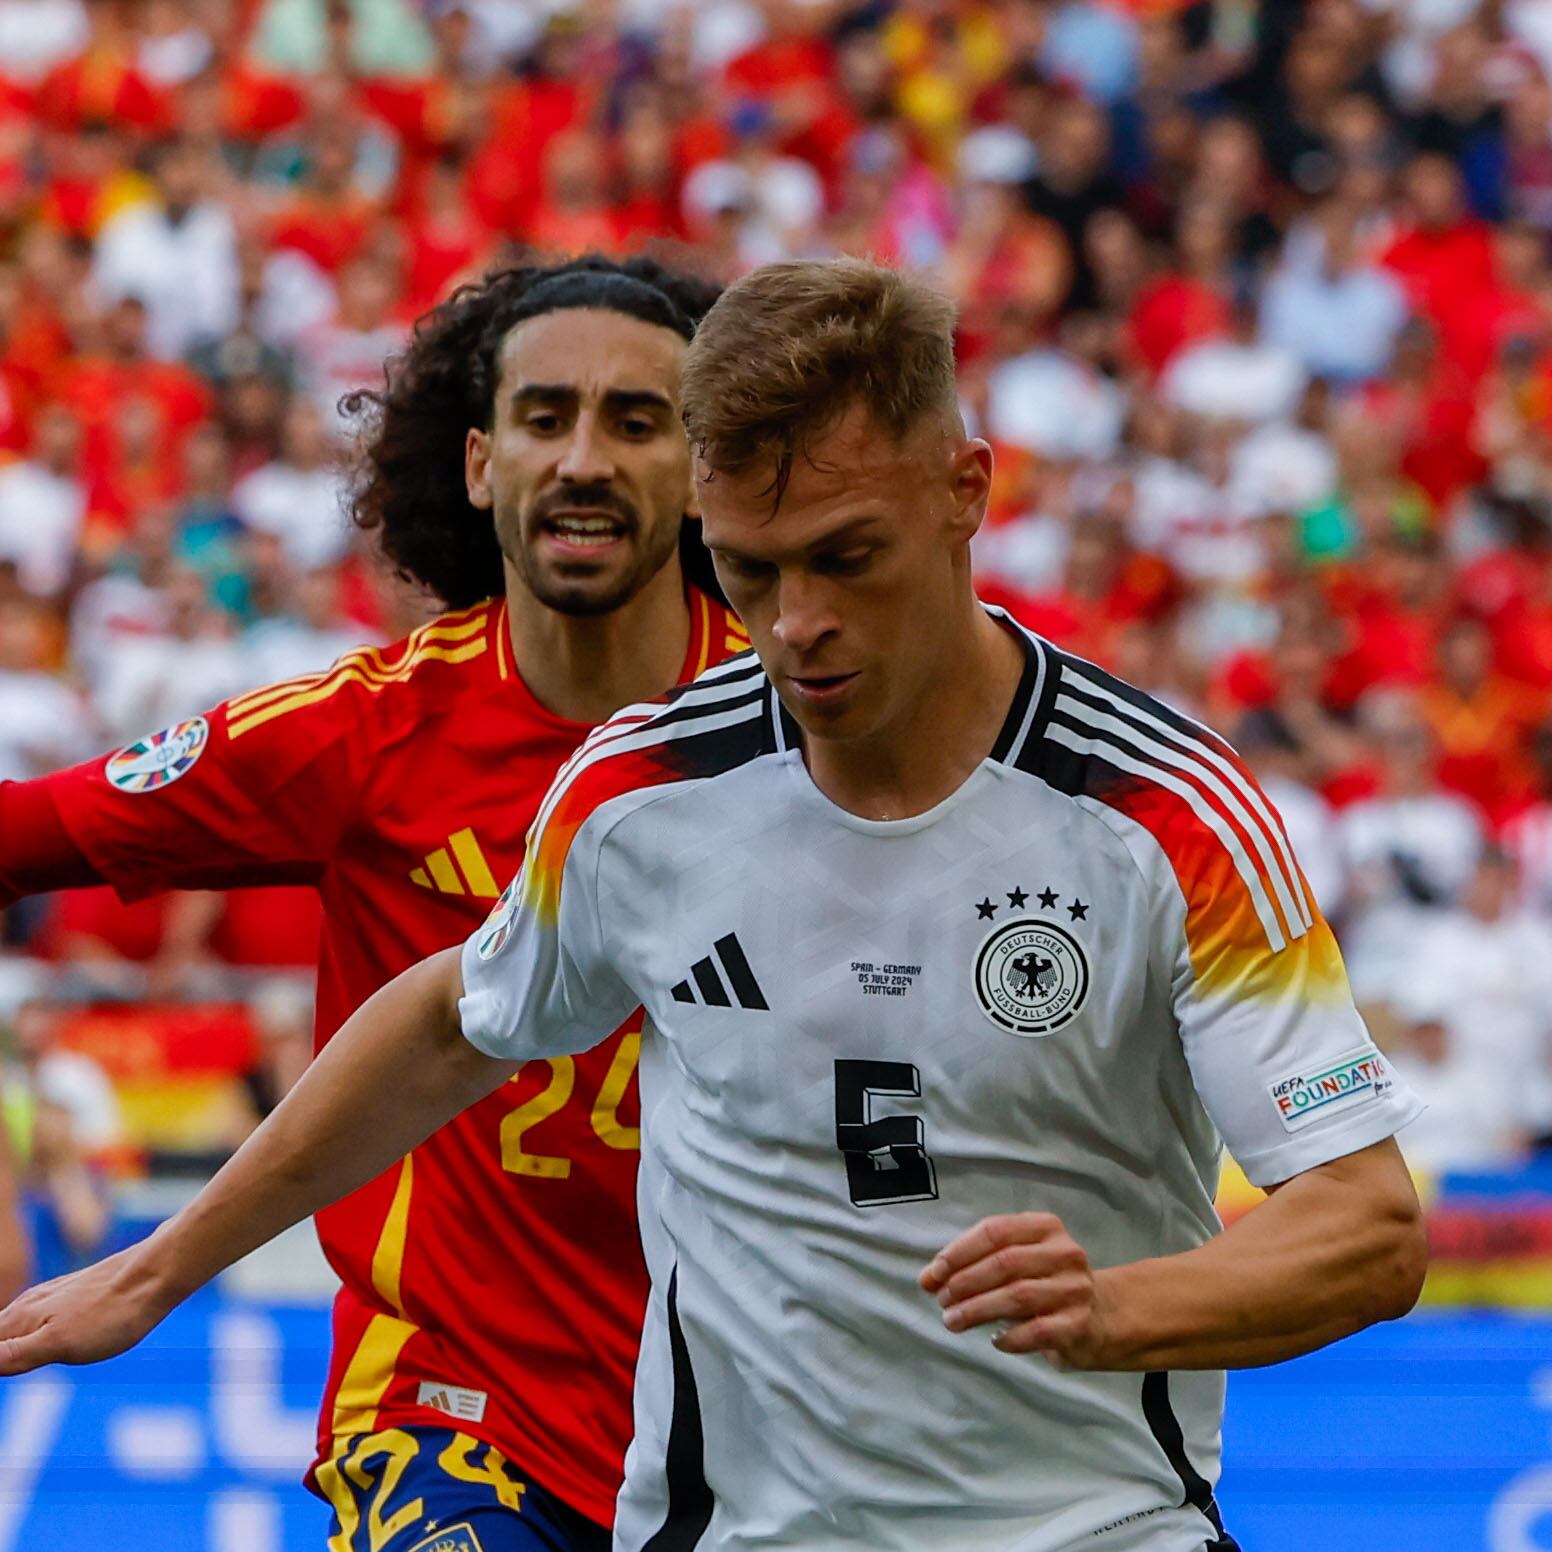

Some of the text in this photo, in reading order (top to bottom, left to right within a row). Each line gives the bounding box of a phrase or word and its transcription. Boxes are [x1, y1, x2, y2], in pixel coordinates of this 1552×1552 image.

[1000, 934, 1064, 956] DEUTSCHER
[850, 962, 874, 973] SPAIN
[883, 964, 922, 976] GERMANY
[871, 974, 890, 985] JULY
[891, 975, 913, 986] 2024
[863, 984, 907, 997] STUTTGART
[993, 987, 1071, 1019] FUSSBALL-BUND
[1273, 1076, 1306, 1098] UEFA
[834, 1058, 940, 1208] 6
